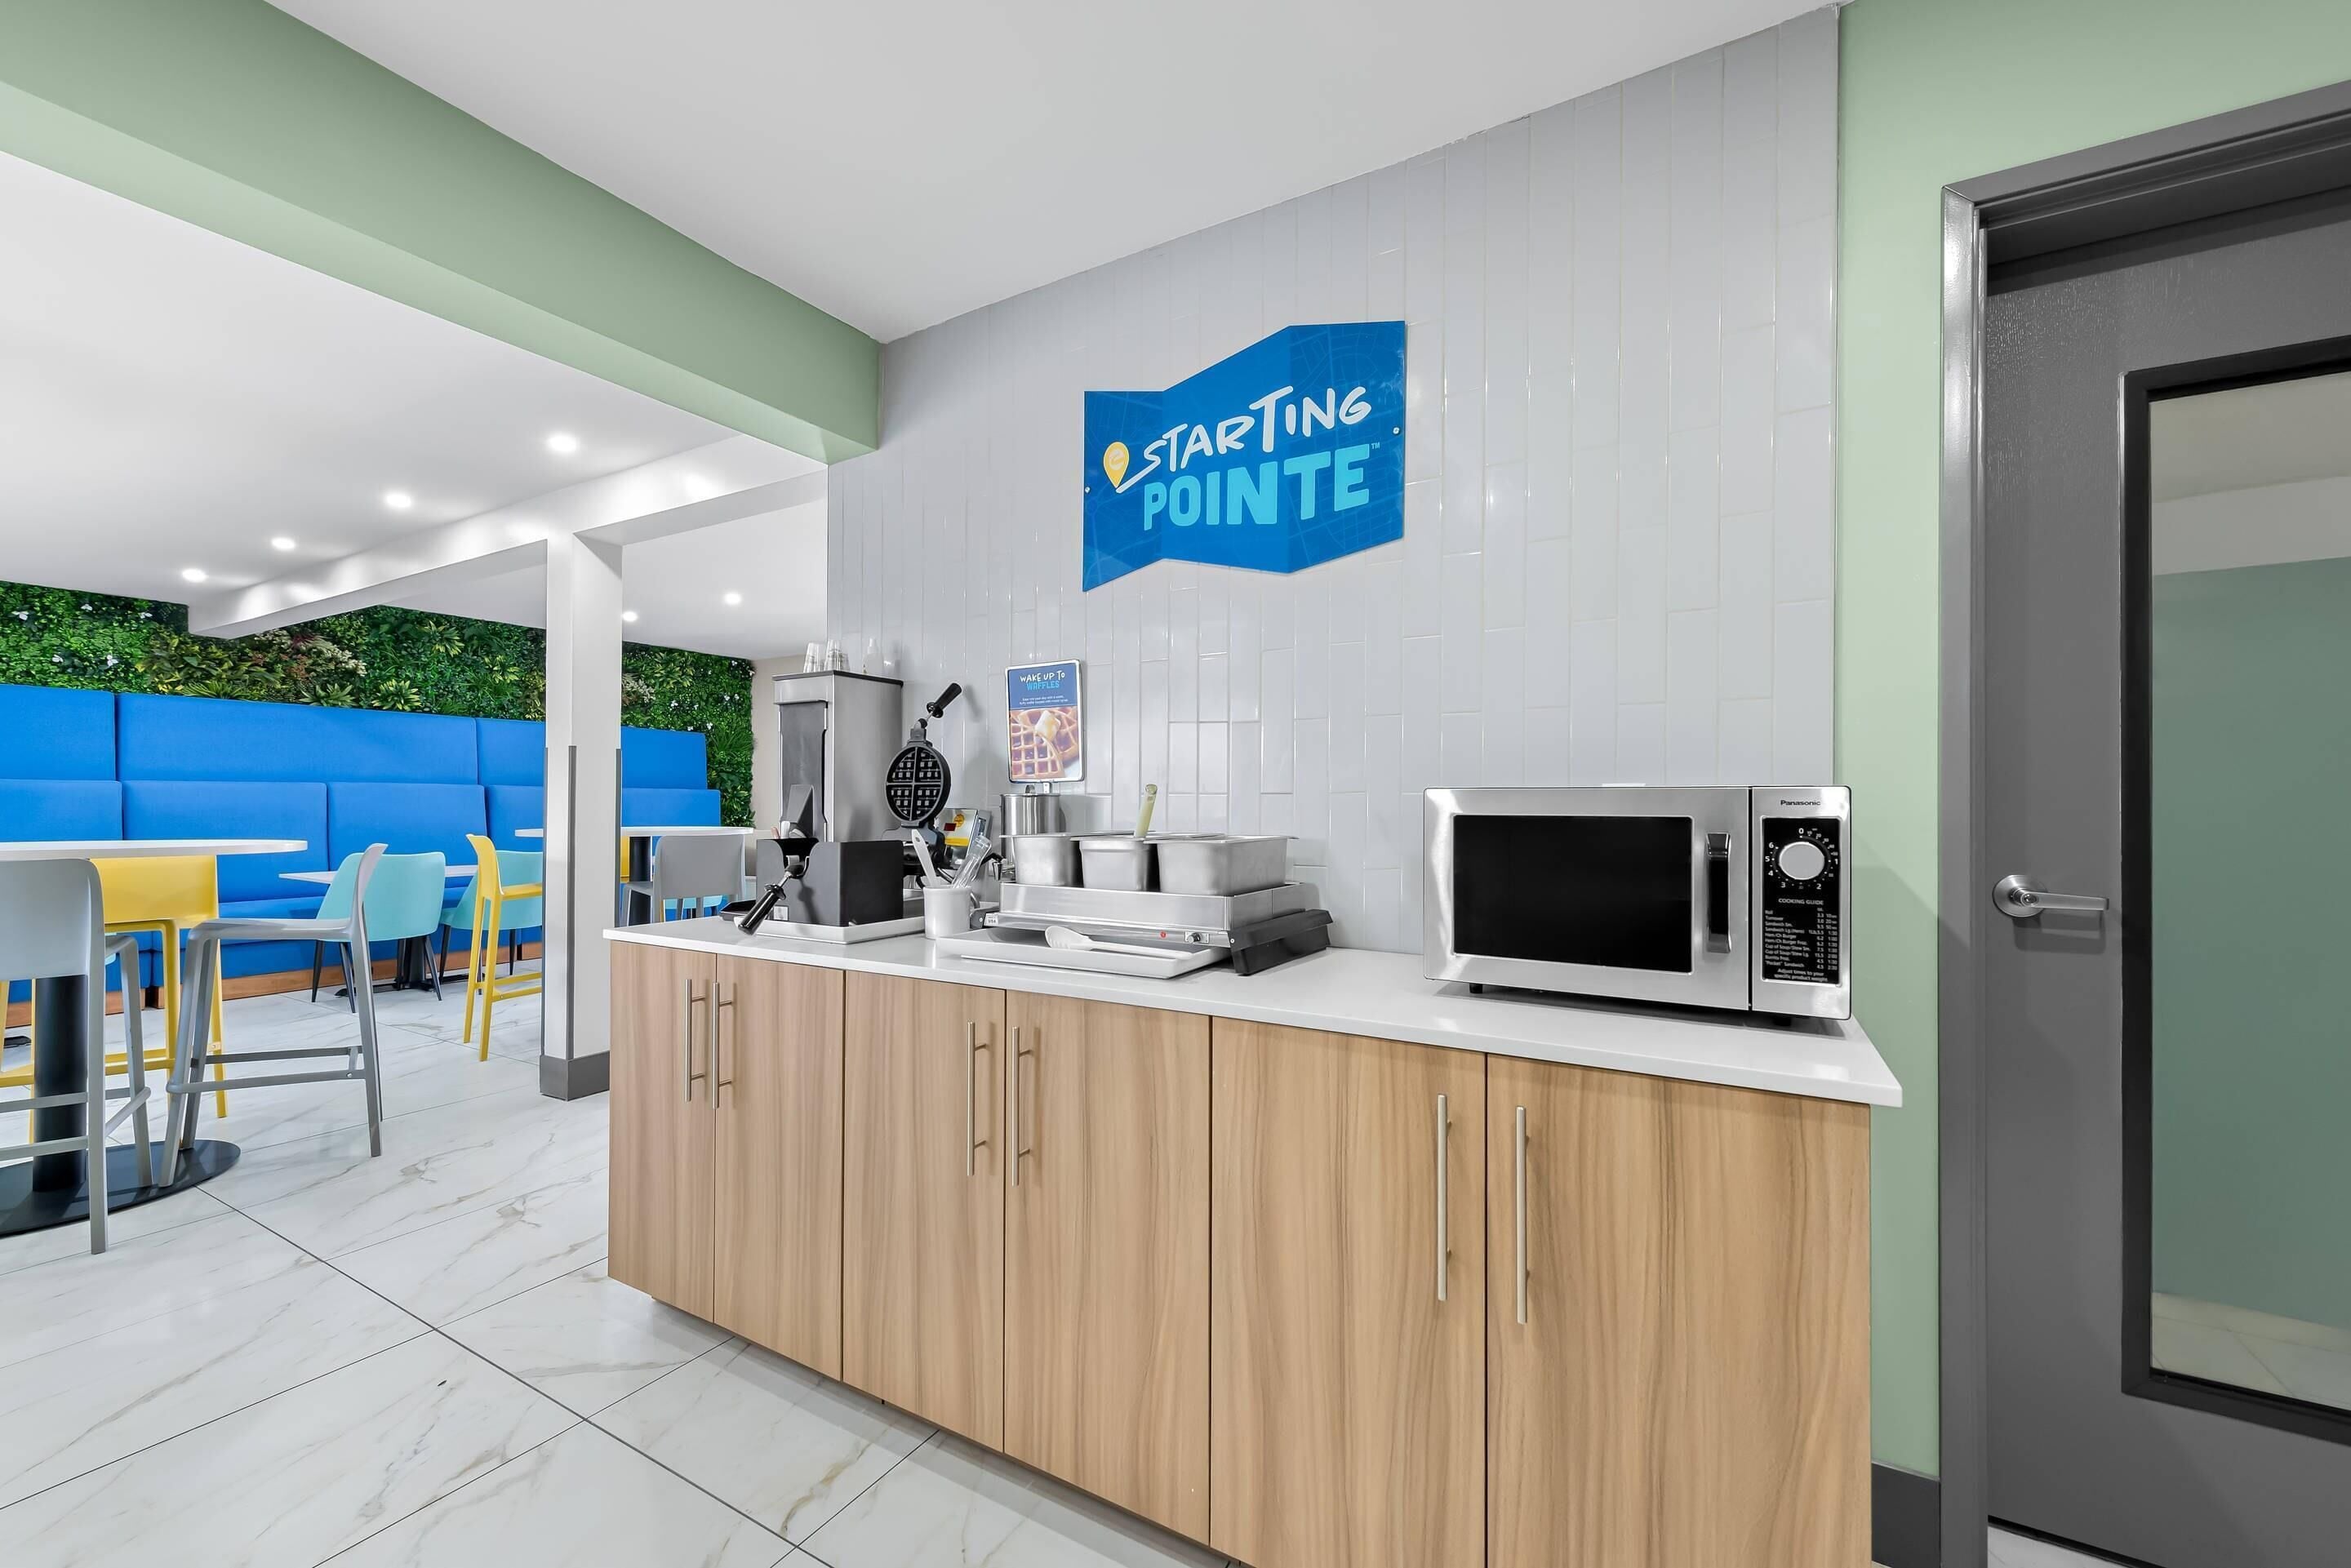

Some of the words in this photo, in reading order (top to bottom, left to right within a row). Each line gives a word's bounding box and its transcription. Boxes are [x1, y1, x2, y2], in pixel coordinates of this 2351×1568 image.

[1116, 386, 1372, 493] STARTING
[1144, 444, 1370, 531] POINTE
[1020, 673, 1041, 682] WAKE
[1027, 681, 1060, 691] WAFFLES
